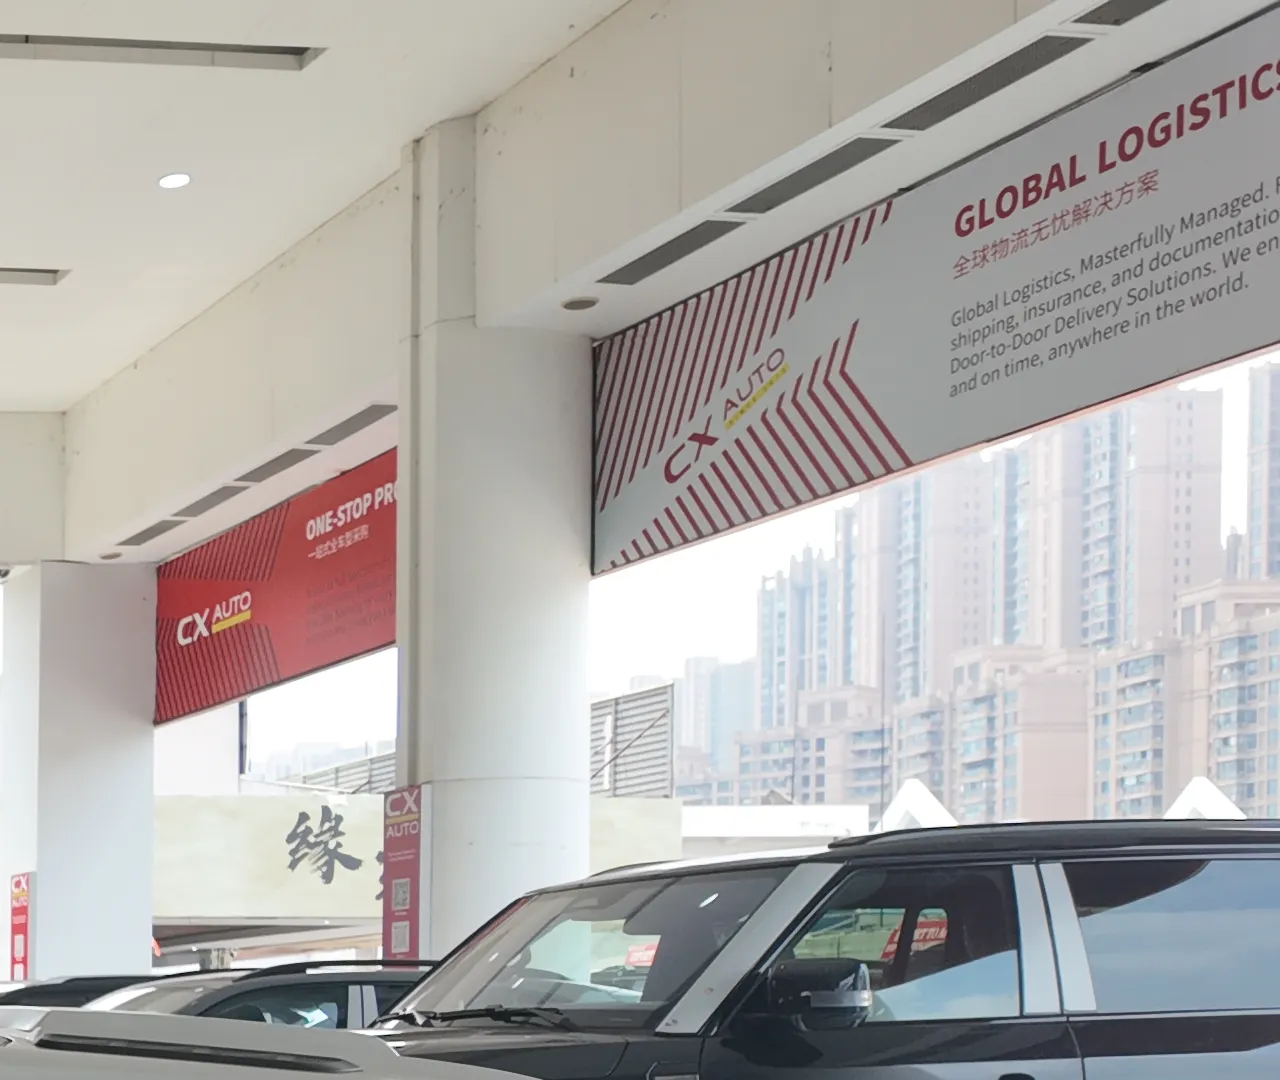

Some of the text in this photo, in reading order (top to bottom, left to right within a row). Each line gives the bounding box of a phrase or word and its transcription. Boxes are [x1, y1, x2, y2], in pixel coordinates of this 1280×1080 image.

[954, 59, 1280, 238] GLOBAL LOGISTIC
[950, 208, 1280, 351] shipping, insurance, and documentatio
[951, 293, 999, 328] Global
[1080, 222, 1175, 272] Masterfully
[1180, 181, 1270, 234] Managed.
[952, 168, 1161, 280] 全球物流无忧解决方案
[949, 272, 1250, 398] and on time, anywhere in the world.
[950, 235, 1279, 375] Door-to-Door Delivery Solutions. We en
[663, 414, 719, 485] CX
[723, 347, 786, 421] AUTO
[306, 492, 371, 541] ONE-STOP
[177, 591, 251, 646] CX AUTO
[385, 789, 419, 817] CX
[386, 821, 419, 839] AUTO
[11, 875, 28, 894] CX
